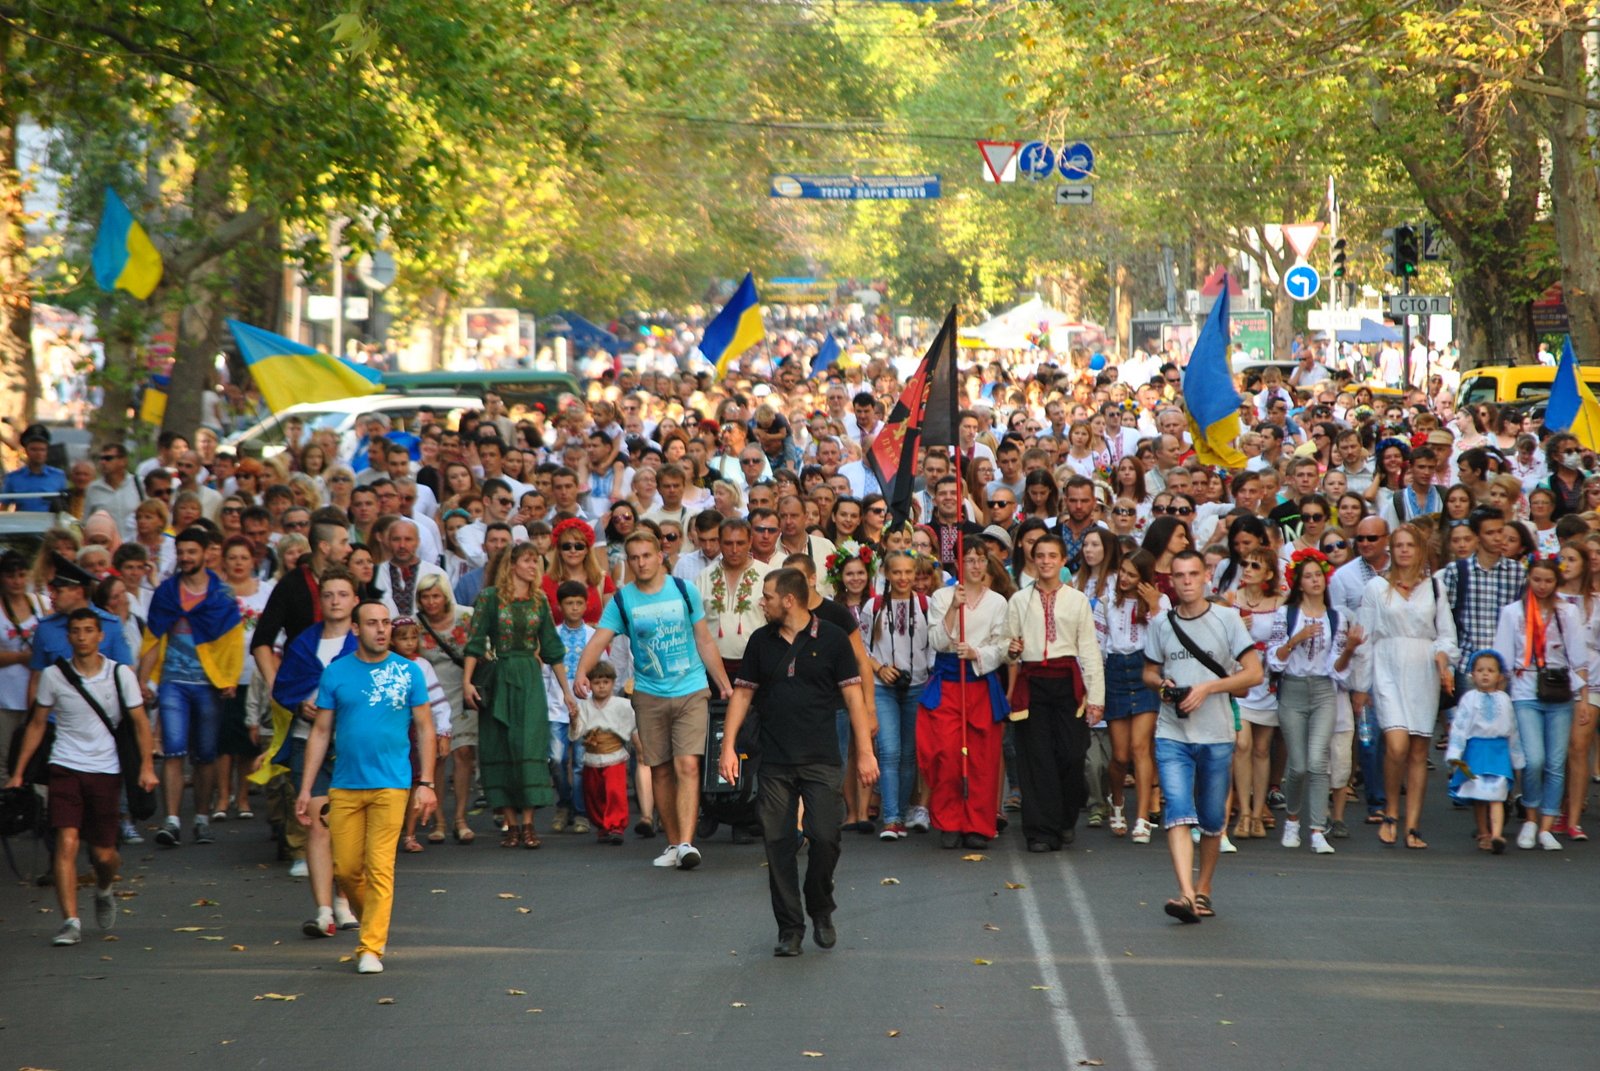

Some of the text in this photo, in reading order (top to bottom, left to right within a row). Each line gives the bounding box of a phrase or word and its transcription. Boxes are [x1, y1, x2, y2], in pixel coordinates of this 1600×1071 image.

[1399, 298, 1440, 312] СТОП
[656, 620, 683, 639] Saint
[1170, 648, 1214, 660] adis
